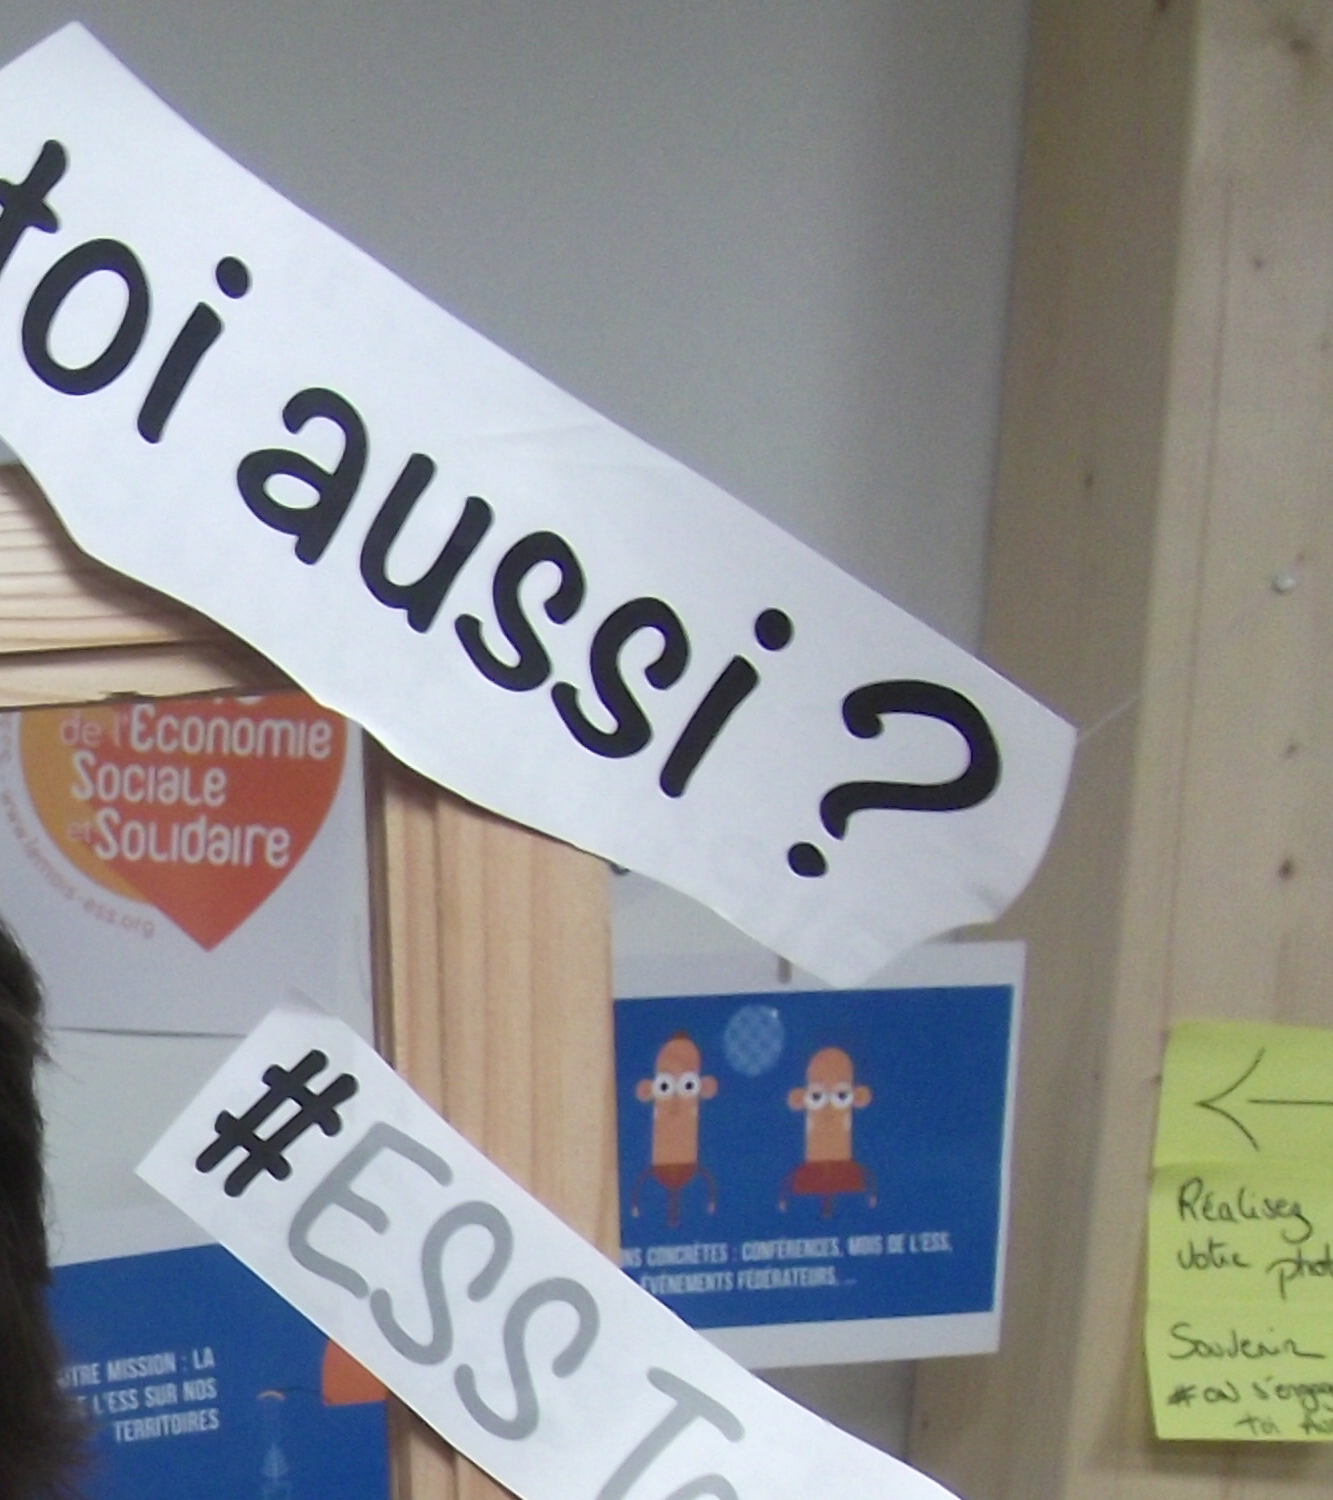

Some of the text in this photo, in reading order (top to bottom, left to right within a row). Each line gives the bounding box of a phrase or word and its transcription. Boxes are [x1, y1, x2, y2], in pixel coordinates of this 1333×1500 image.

[236, 386, 795, 799] aussi
[785, 678, 1001, 879] ?
[58, 707, 103, 747] de
[194, 1048, 600, 1442] #ESS
[106, 1351, 177, 1384] MISSION
[192, 1345, 216, 1372] LA
[144, 1382, 180, 1409] SUR
[183, 1376, 218, 1403] NOS
[112, 1407, 221, 1443] TERRITOIRES
